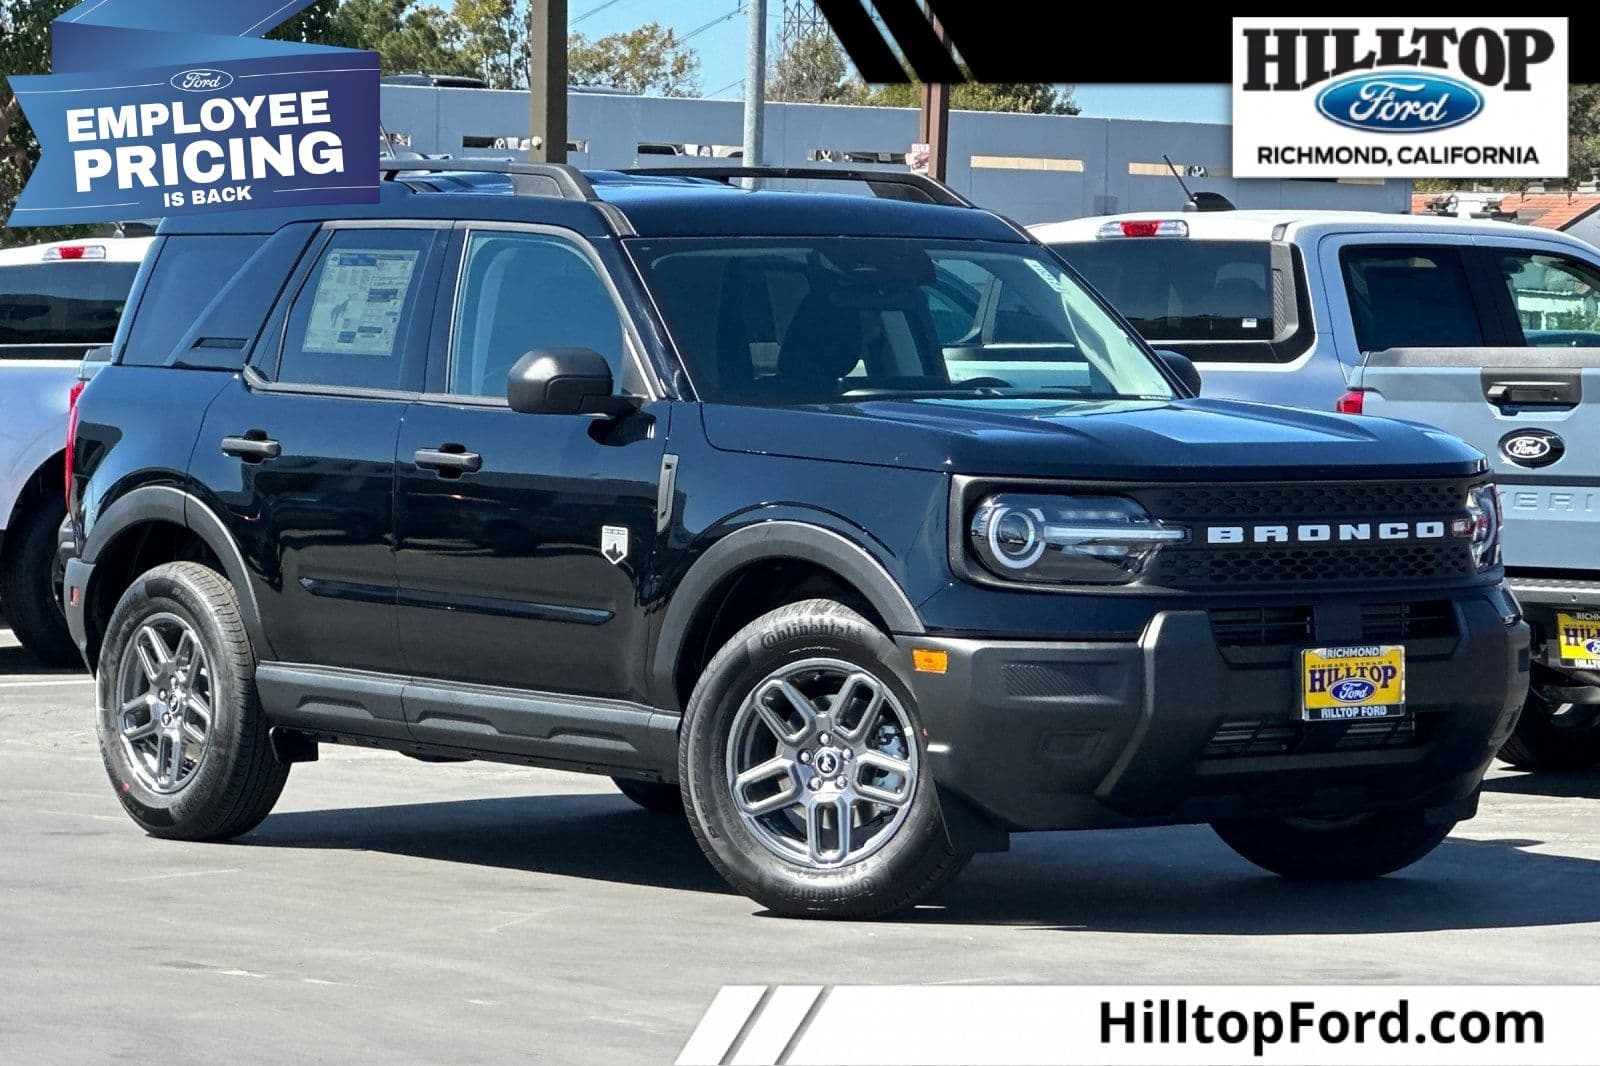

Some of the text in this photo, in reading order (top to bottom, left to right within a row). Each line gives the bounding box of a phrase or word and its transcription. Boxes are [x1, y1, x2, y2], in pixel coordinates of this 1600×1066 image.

[1512, 439, 1542, 455] Ford
[1207, 520, 1444, 544] BRONCO
[1327, 647, 1380, 658] RICHMOND
[1309, 665, 1397, 692] HILLTOP
[1339, 682, 1369, 699] Ford
[1321, 706, 1387, 718] HILLTOP FORD
